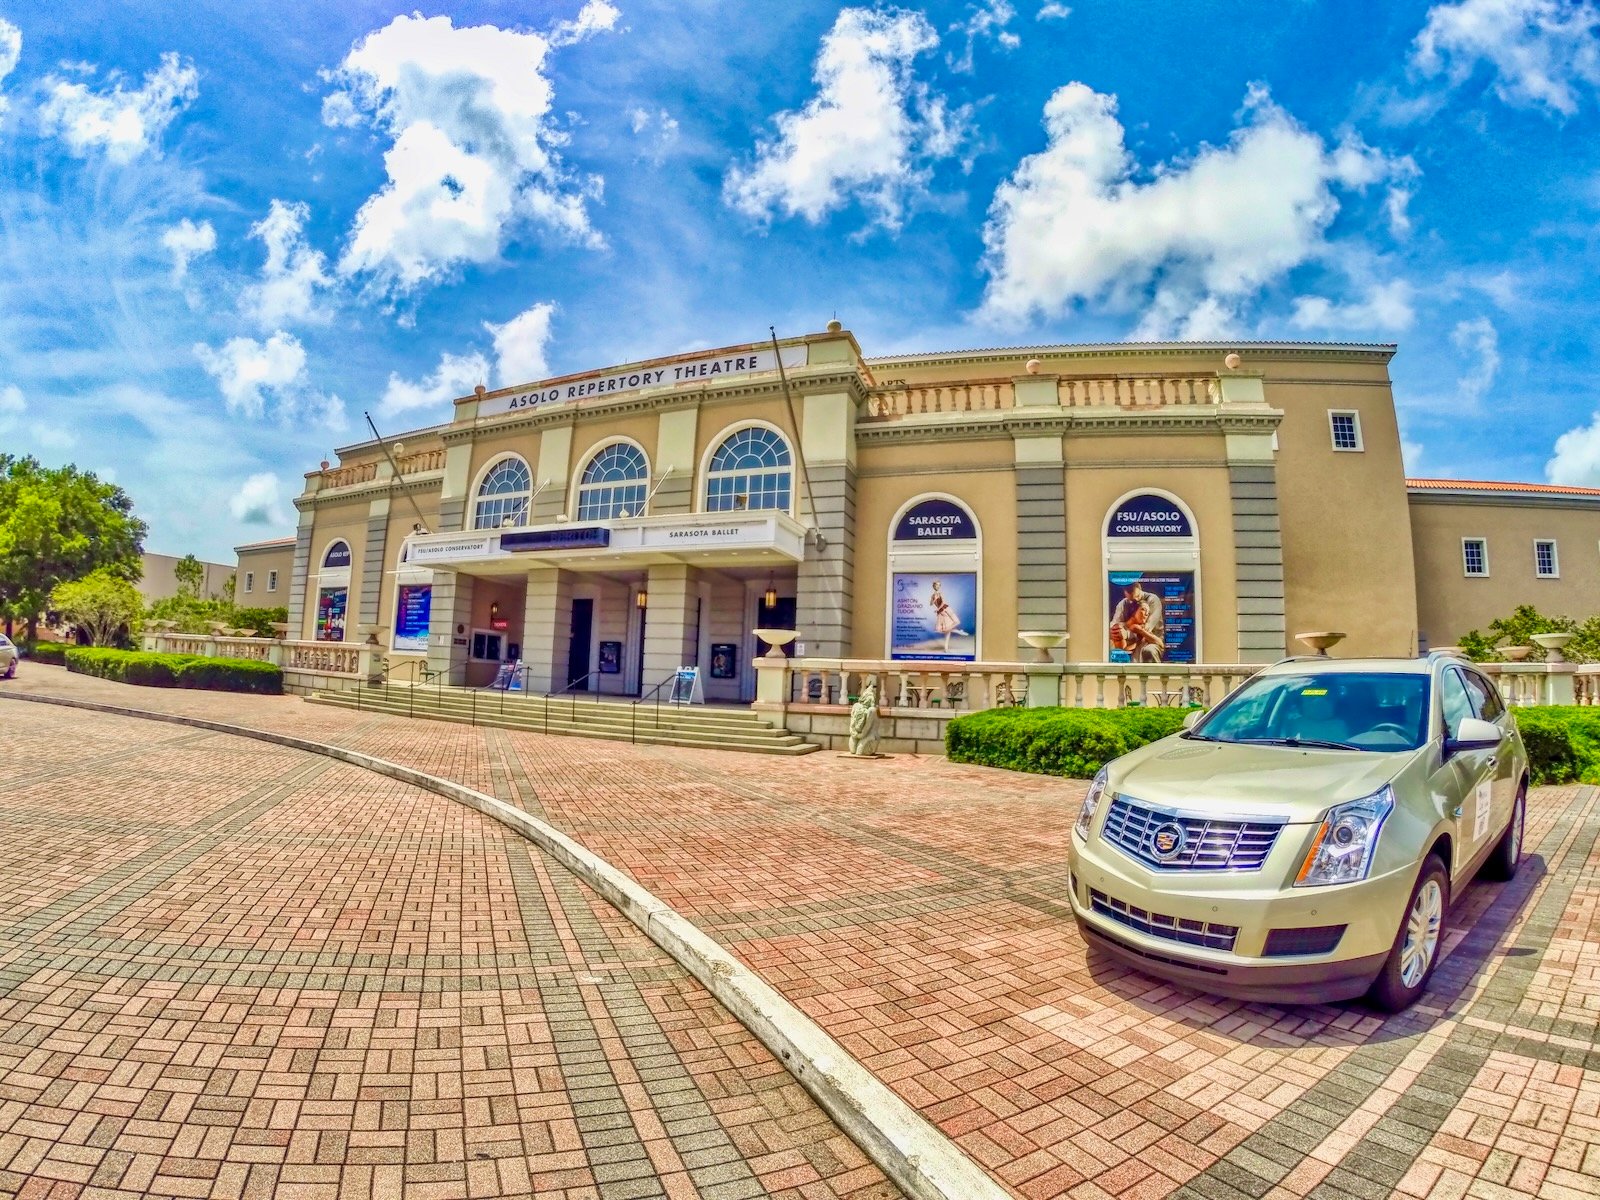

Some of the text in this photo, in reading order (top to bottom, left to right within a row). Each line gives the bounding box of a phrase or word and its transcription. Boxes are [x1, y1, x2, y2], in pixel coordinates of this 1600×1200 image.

[509, 355, 758, 409] ASOLO REPERTORY THEATRE
[908, 515, 962, 525] SARASOTA
[1117, 511, 1180, 522] FSU/ASOLO
[669, 528, 739, 538] SARASOTA BALLET
[917, 527, 953, 537] BALLET
[1116, 525, 1182, 533] CONSERVATORY
[445, 544, 484, 552] CONSERVATORY
